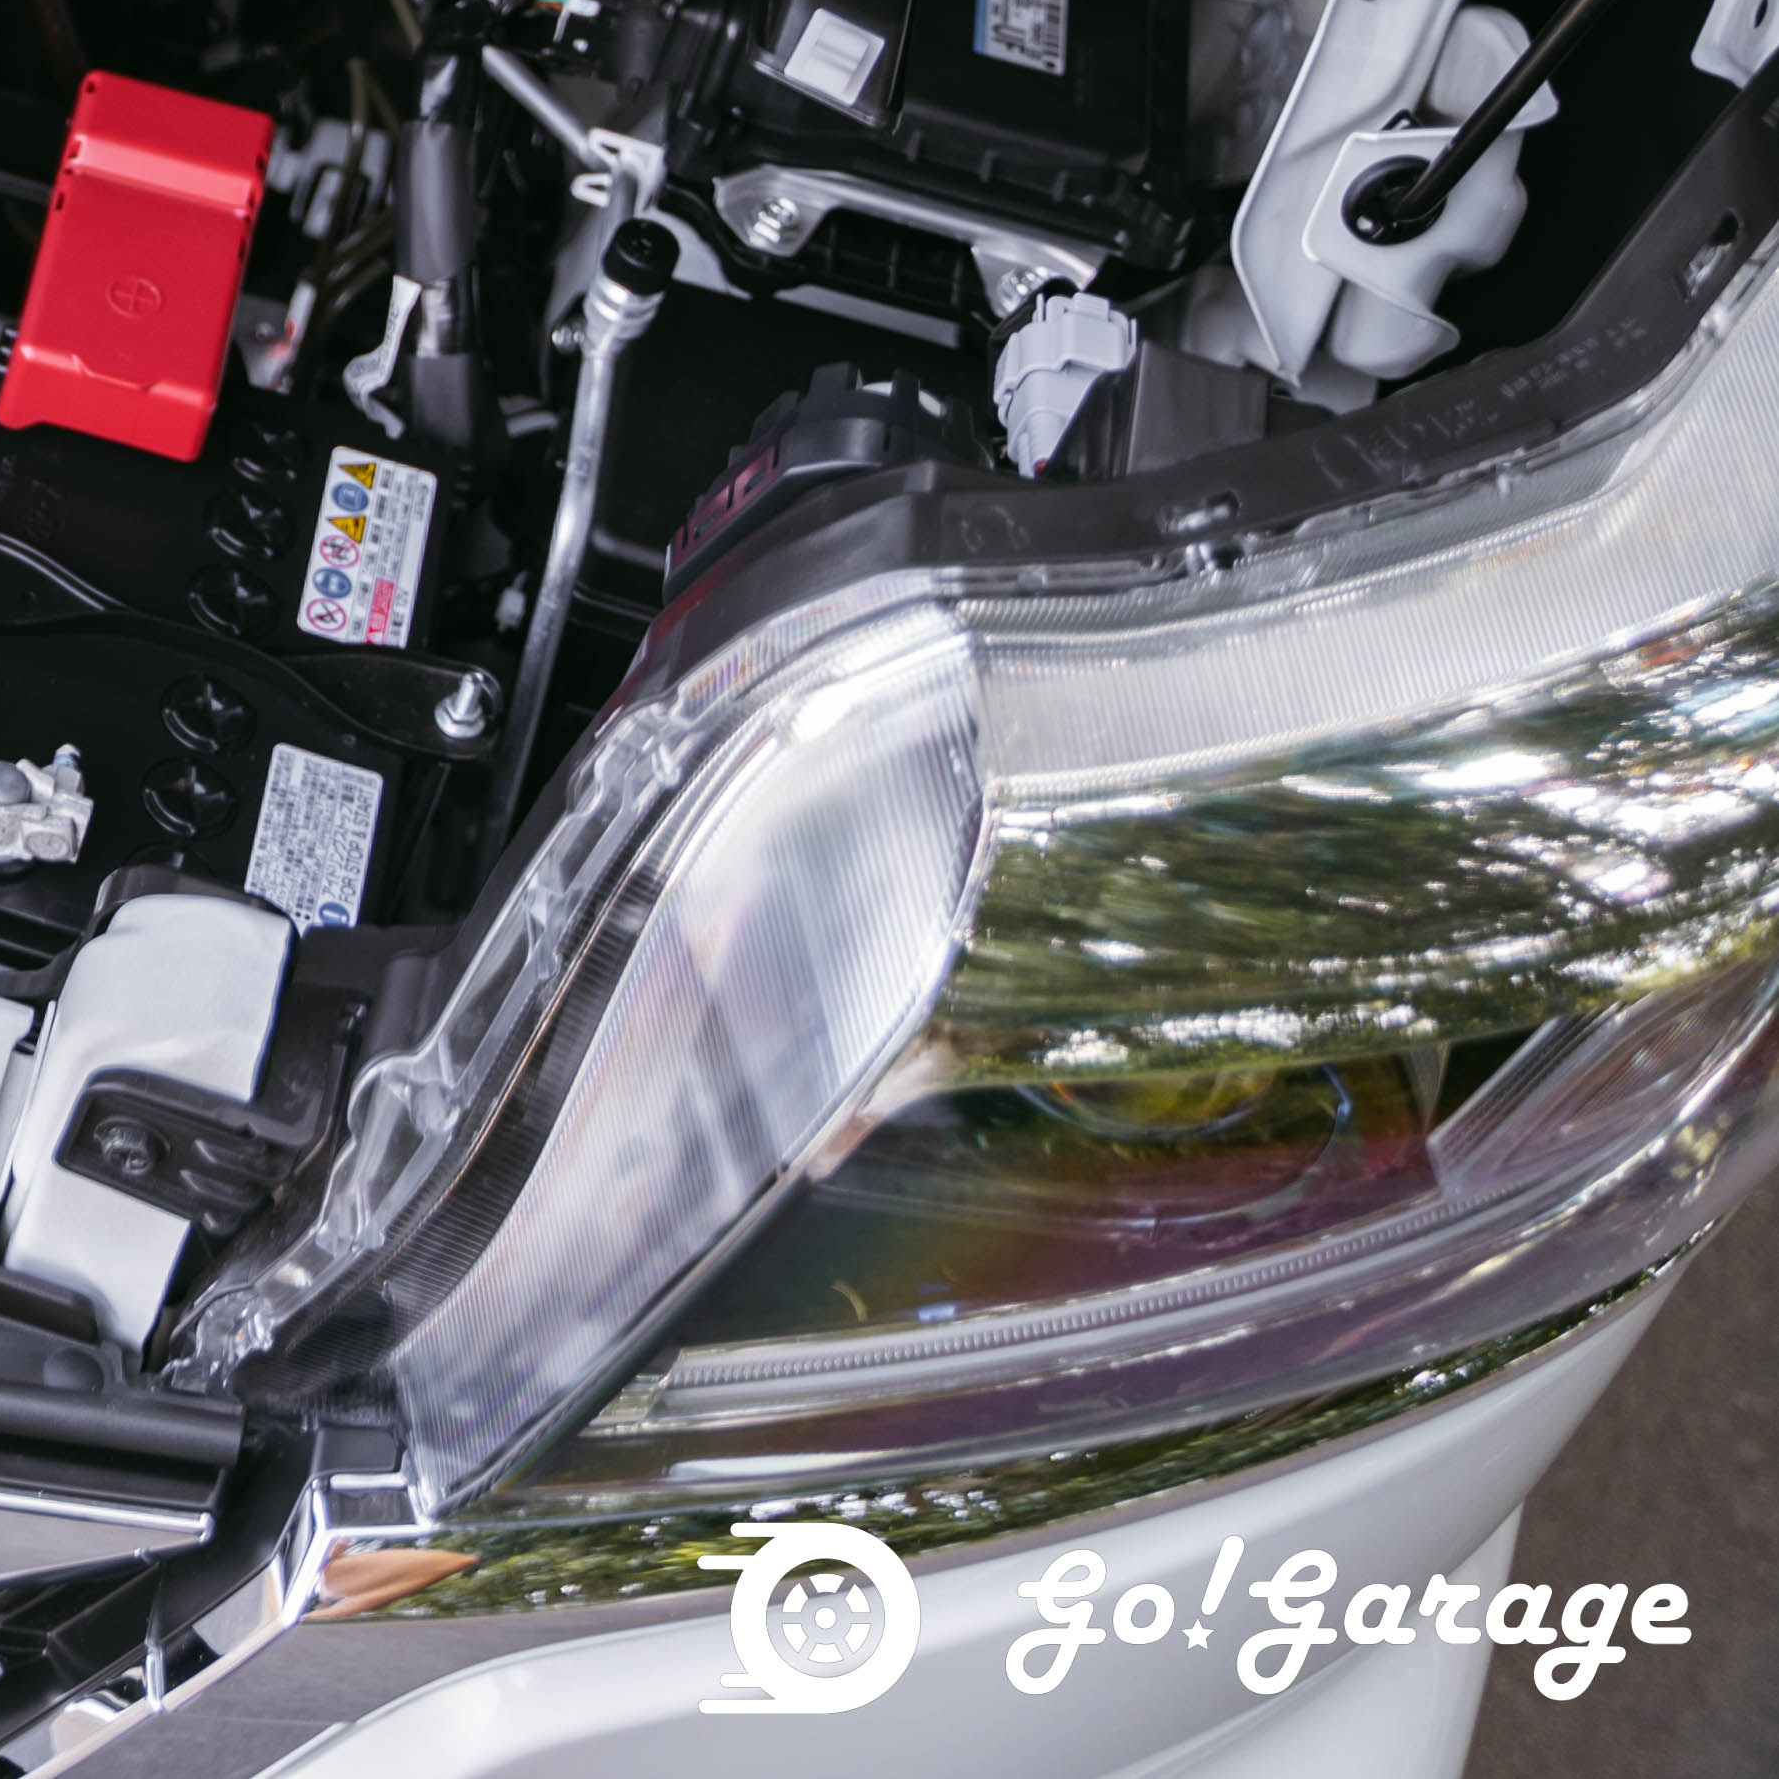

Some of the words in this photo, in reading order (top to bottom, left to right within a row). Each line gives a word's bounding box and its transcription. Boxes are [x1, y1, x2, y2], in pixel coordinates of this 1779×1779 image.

[353, 788, 374, 827] START
[345, 839, 364, 874] STOP
[339, 876, 357, 904] FOR
